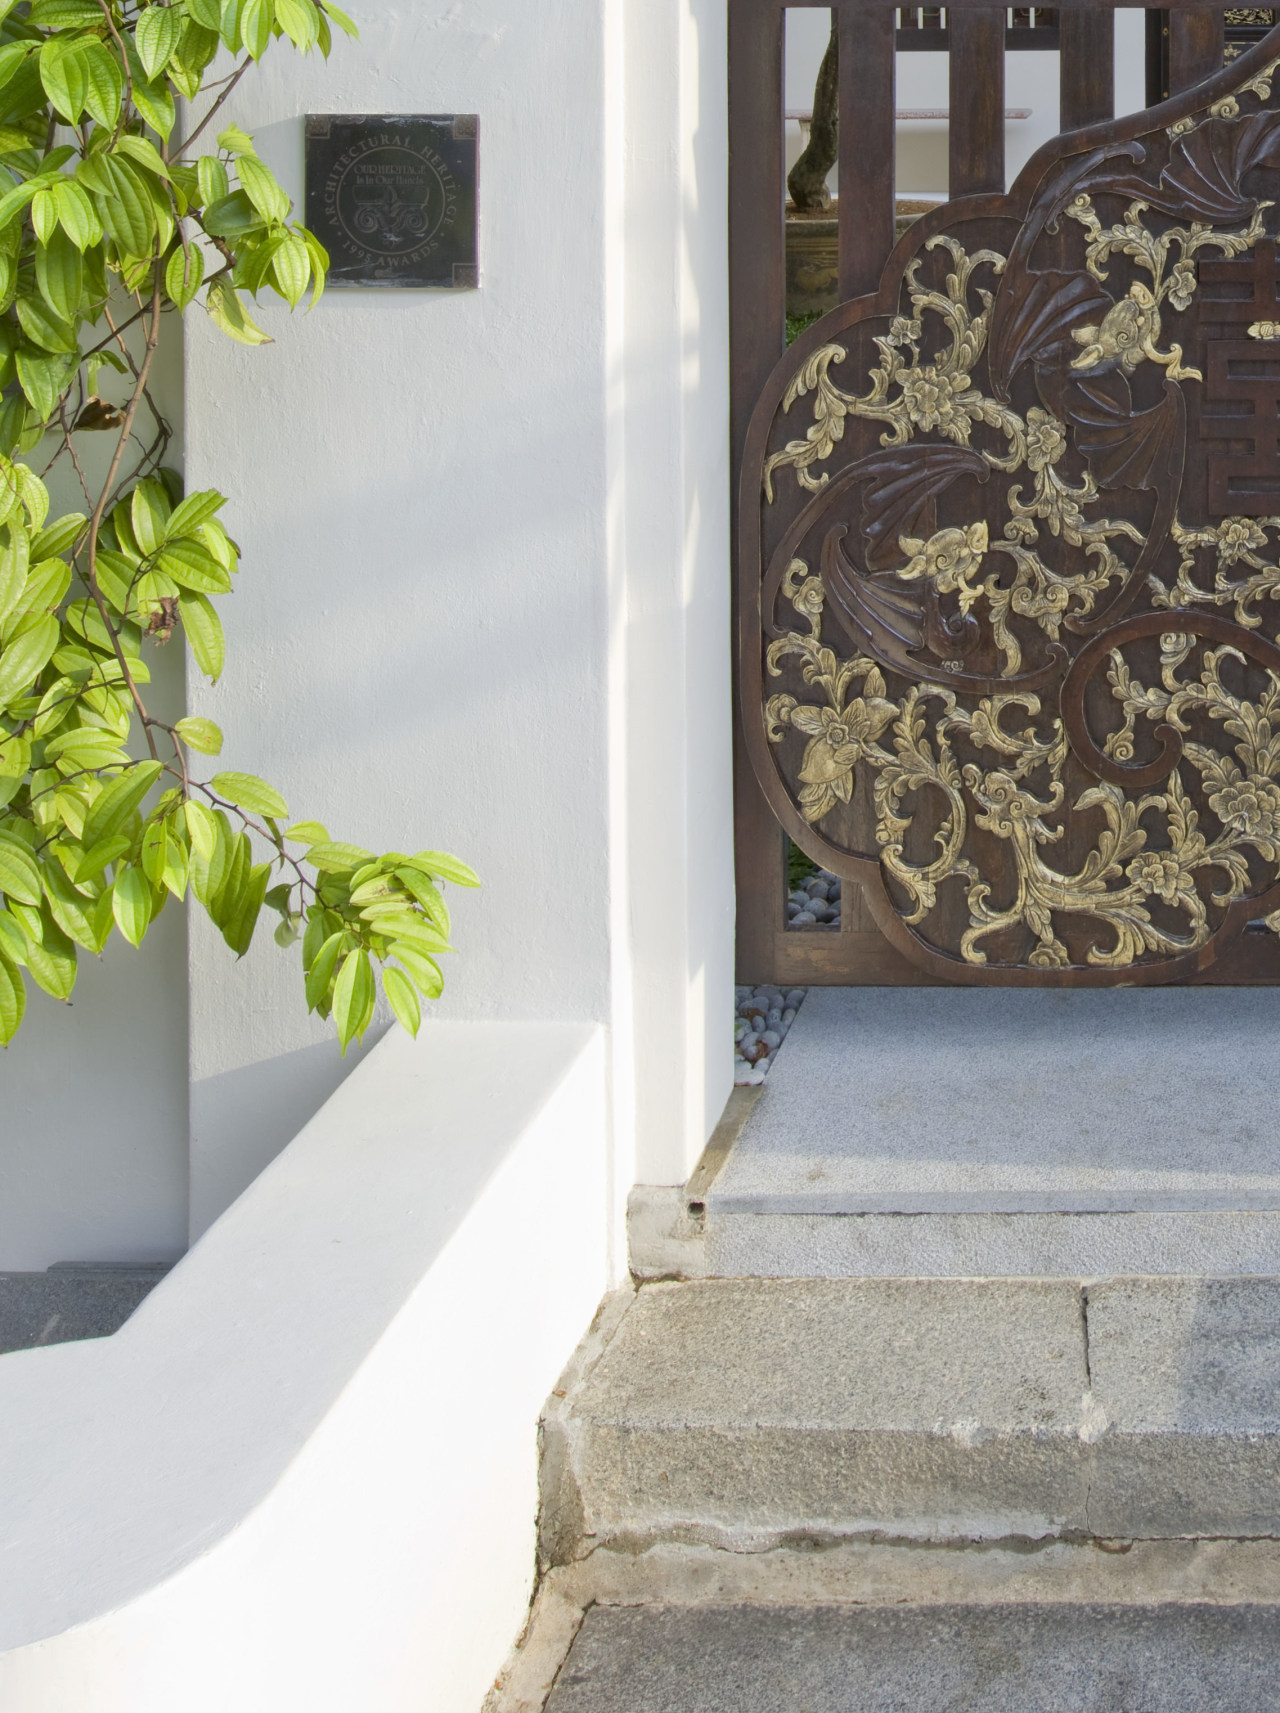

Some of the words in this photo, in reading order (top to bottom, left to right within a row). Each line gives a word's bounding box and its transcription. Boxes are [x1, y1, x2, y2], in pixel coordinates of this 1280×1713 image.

[324, 134, 411, 225] ARCHITECTURAL
[420, 146, 457, 225] HERITAGE
[378, 165, 426, 175] HERITAGE
[342, 240, 373, 264] 1995
[376, 239, 439, 267] AWARDS
